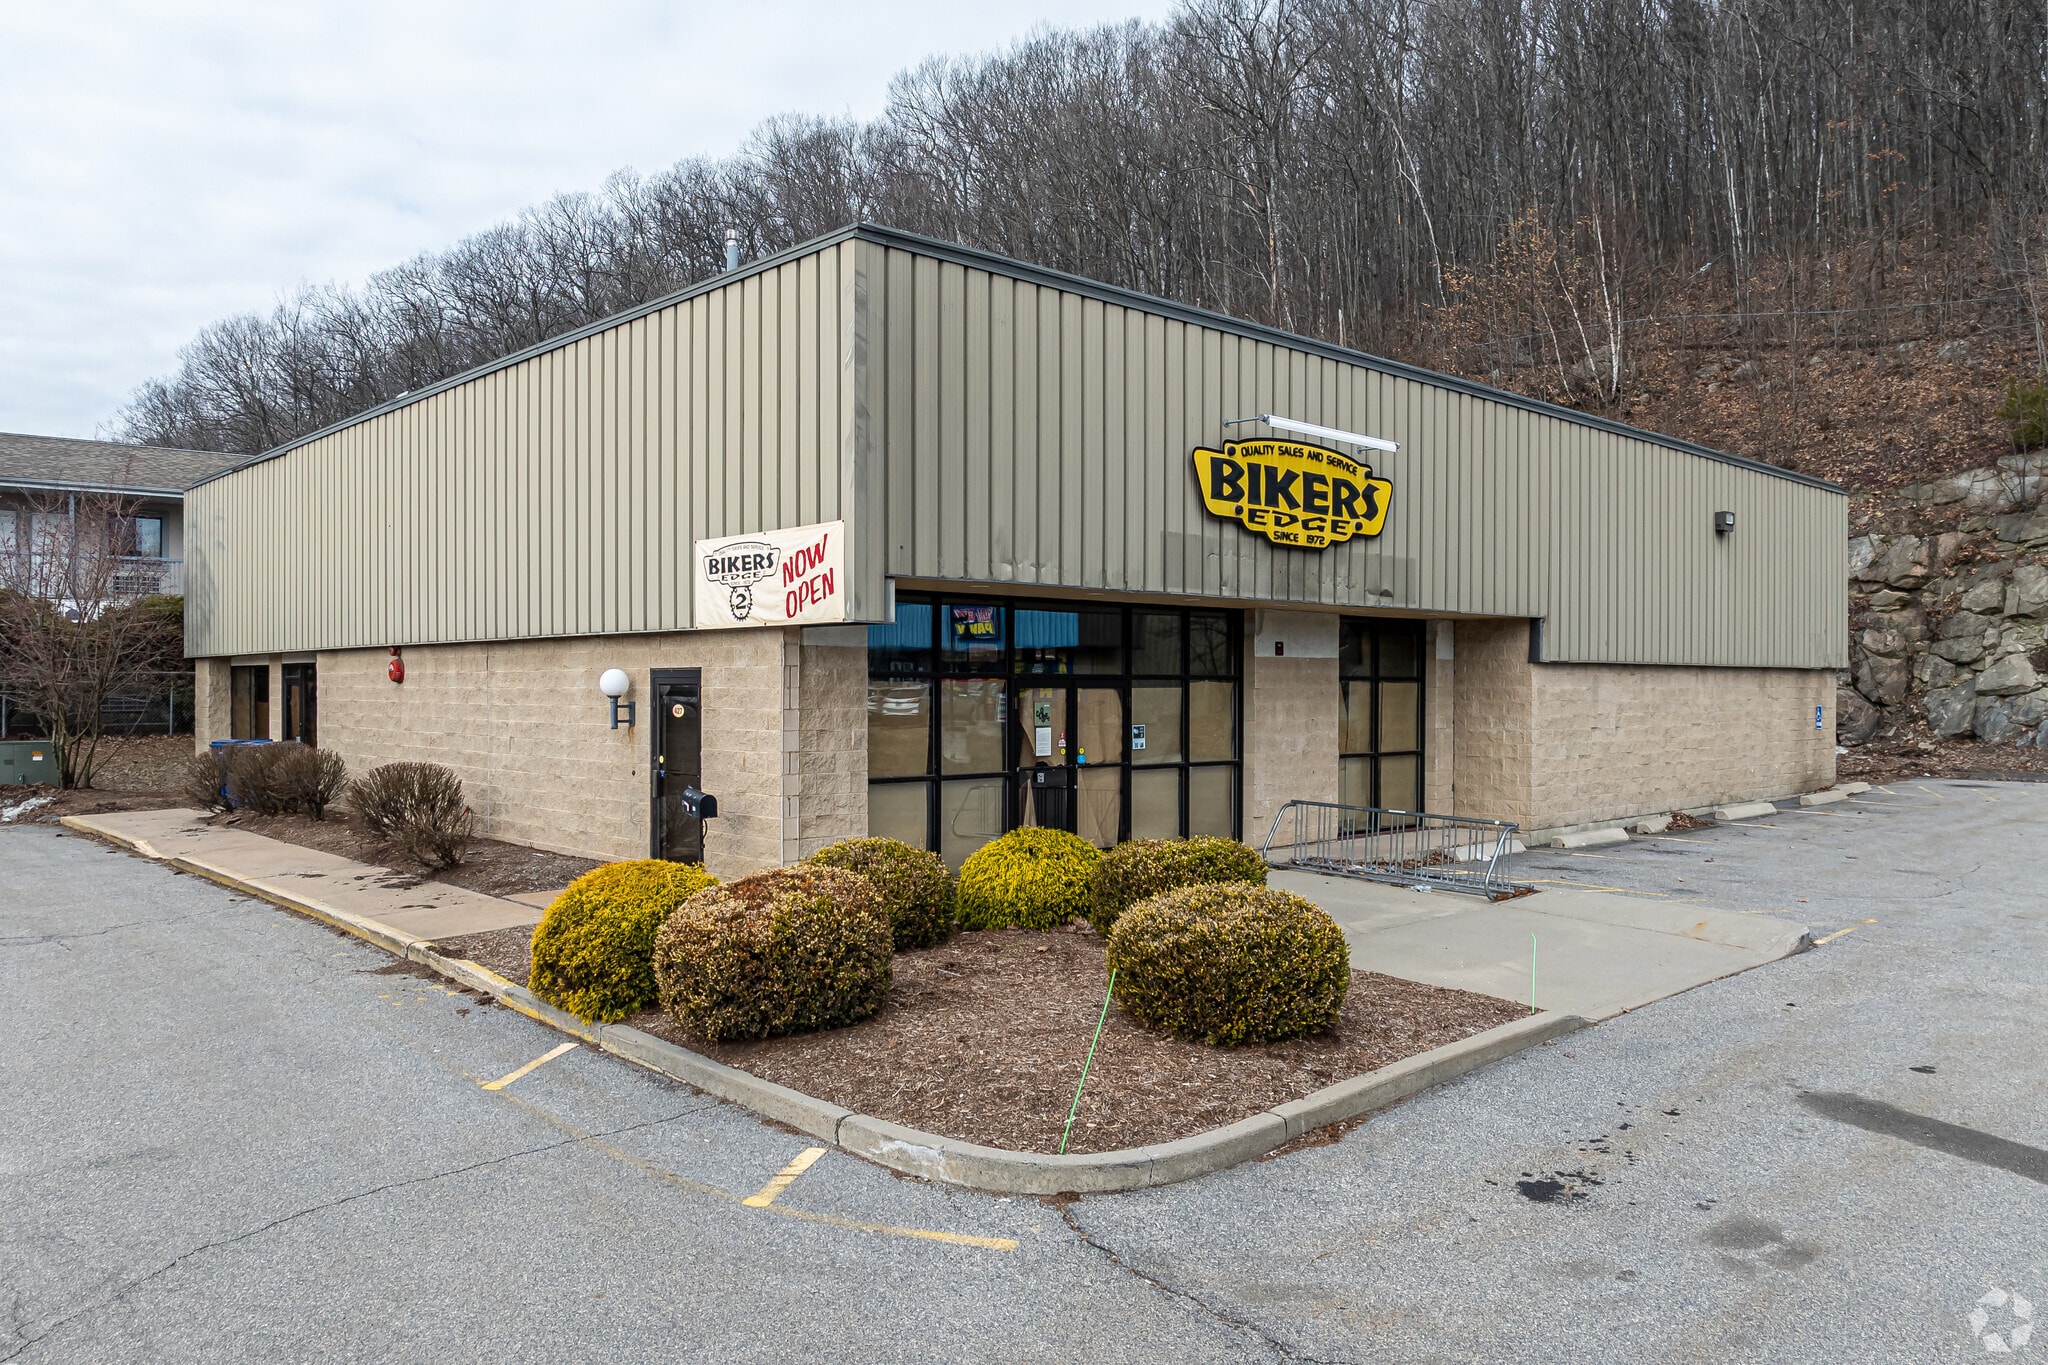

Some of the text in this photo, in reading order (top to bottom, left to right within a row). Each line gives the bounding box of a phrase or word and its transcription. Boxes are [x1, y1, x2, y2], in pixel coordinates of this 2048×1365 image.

[1241, 445, 1358, 476] QUALITY SALES AND SERVICE
[1210, 457, 1380, 521] BIKERS
[1248, 508, 1350, 536] EDGE
[1273, 531, 1325, 545] SINCE 1972
[709, 552, 774, 575] BIKERS
[782, 533, 828, 588] NOW
[722, 570, 761, 581] EDGE
[735, 594, 747, 610] 2
[785, 567, 835, 618] OPEN
